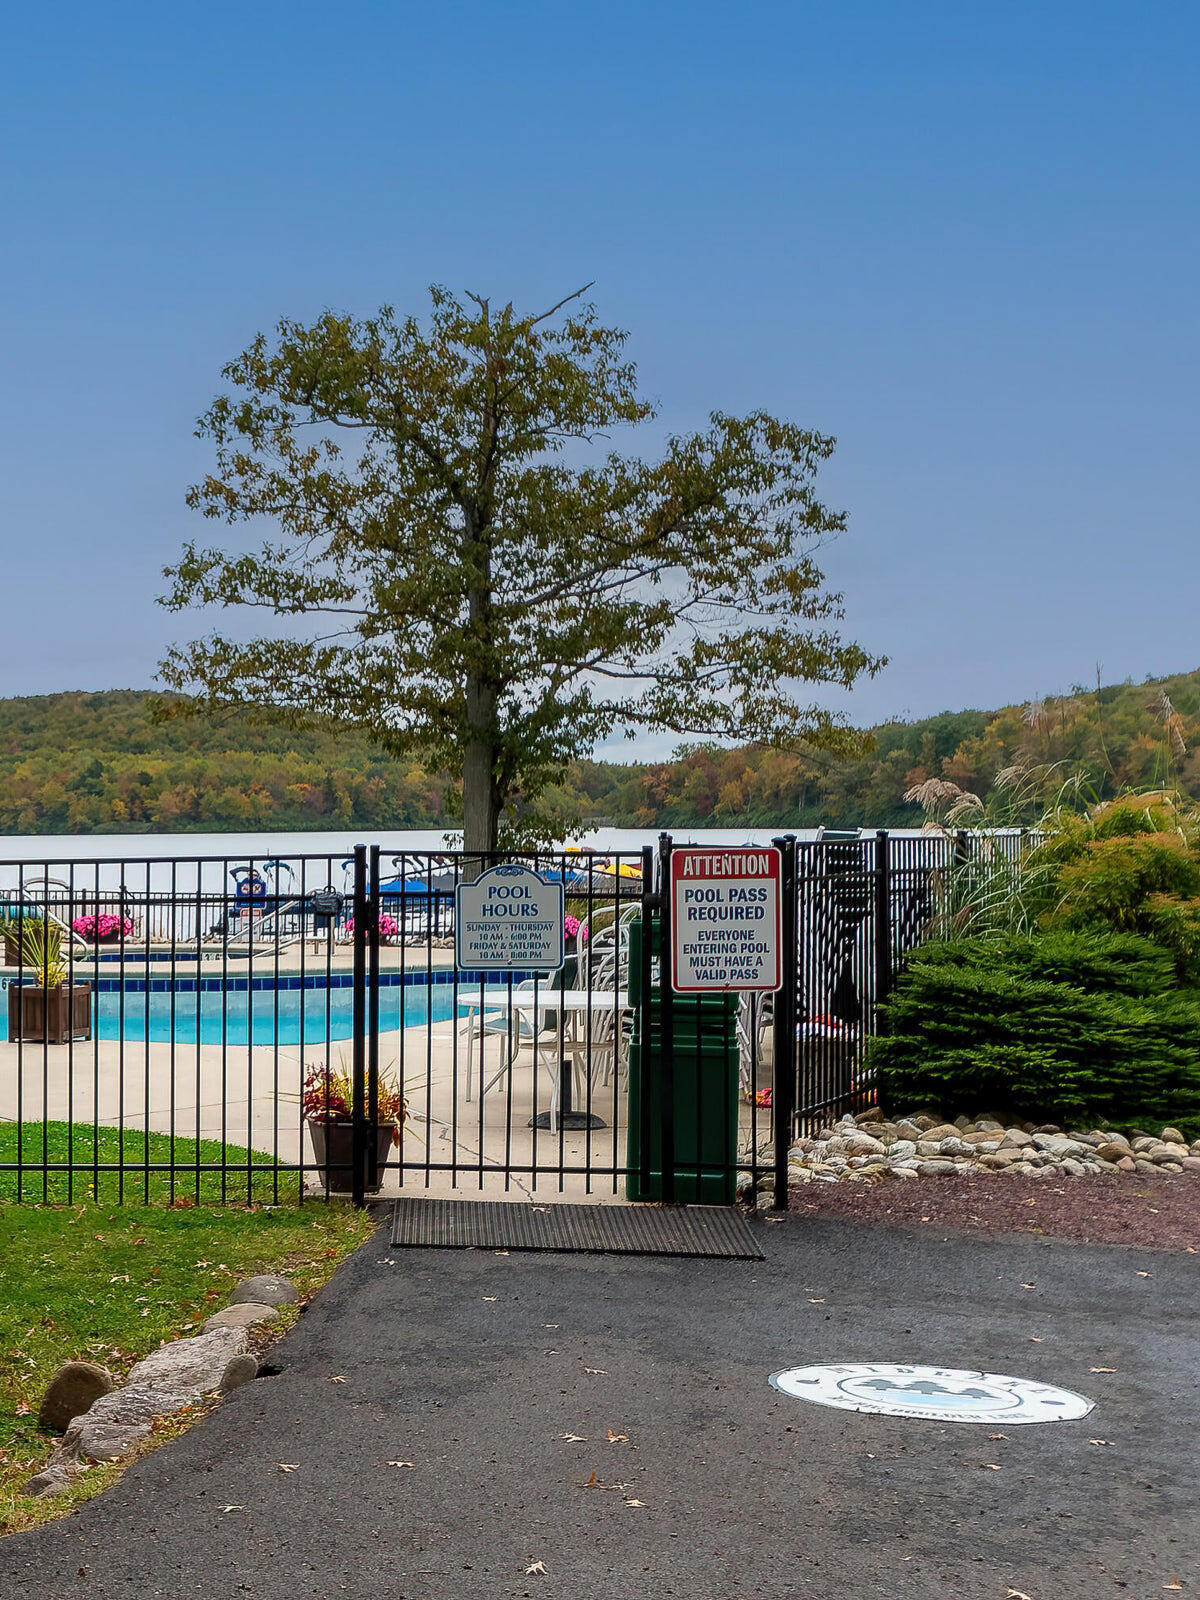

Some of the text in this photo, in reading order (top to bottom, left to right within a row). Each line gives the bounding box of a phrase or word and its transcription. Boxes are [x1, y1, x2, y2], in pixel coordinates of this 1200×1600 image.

[683, 854, 769, 876] ATTENTION
[488, 886, 532, 899] POOL
[685, 888, 768, 903] POOL PASS
[482, 903, 539, 917] HOURS
[688, 906, 765, 923] REQUIRED
[466, 923, 500, 931] SUNDAY
[510, 923, 554, 931] THURSDAY
[480, 933, 488, 941] 10
[490, 933, 503, 941] AM
[530, 933, 542, 941] PM
[698, 930, 755, 941] EVERYONE
[470, 942, 498, 950] FRIDAY
[509, 942, 551, 950] SATURDAY
[683, 943, 770, 955] ENTERING POOL
[480, 951, 488, 959] 10
[490, 951, 503, 959] AM
[530, 951, 542, 959] PM
[689, 956, 763, 968] MUST HAVE A
[695, 969, 759, 981] VALID PASS
